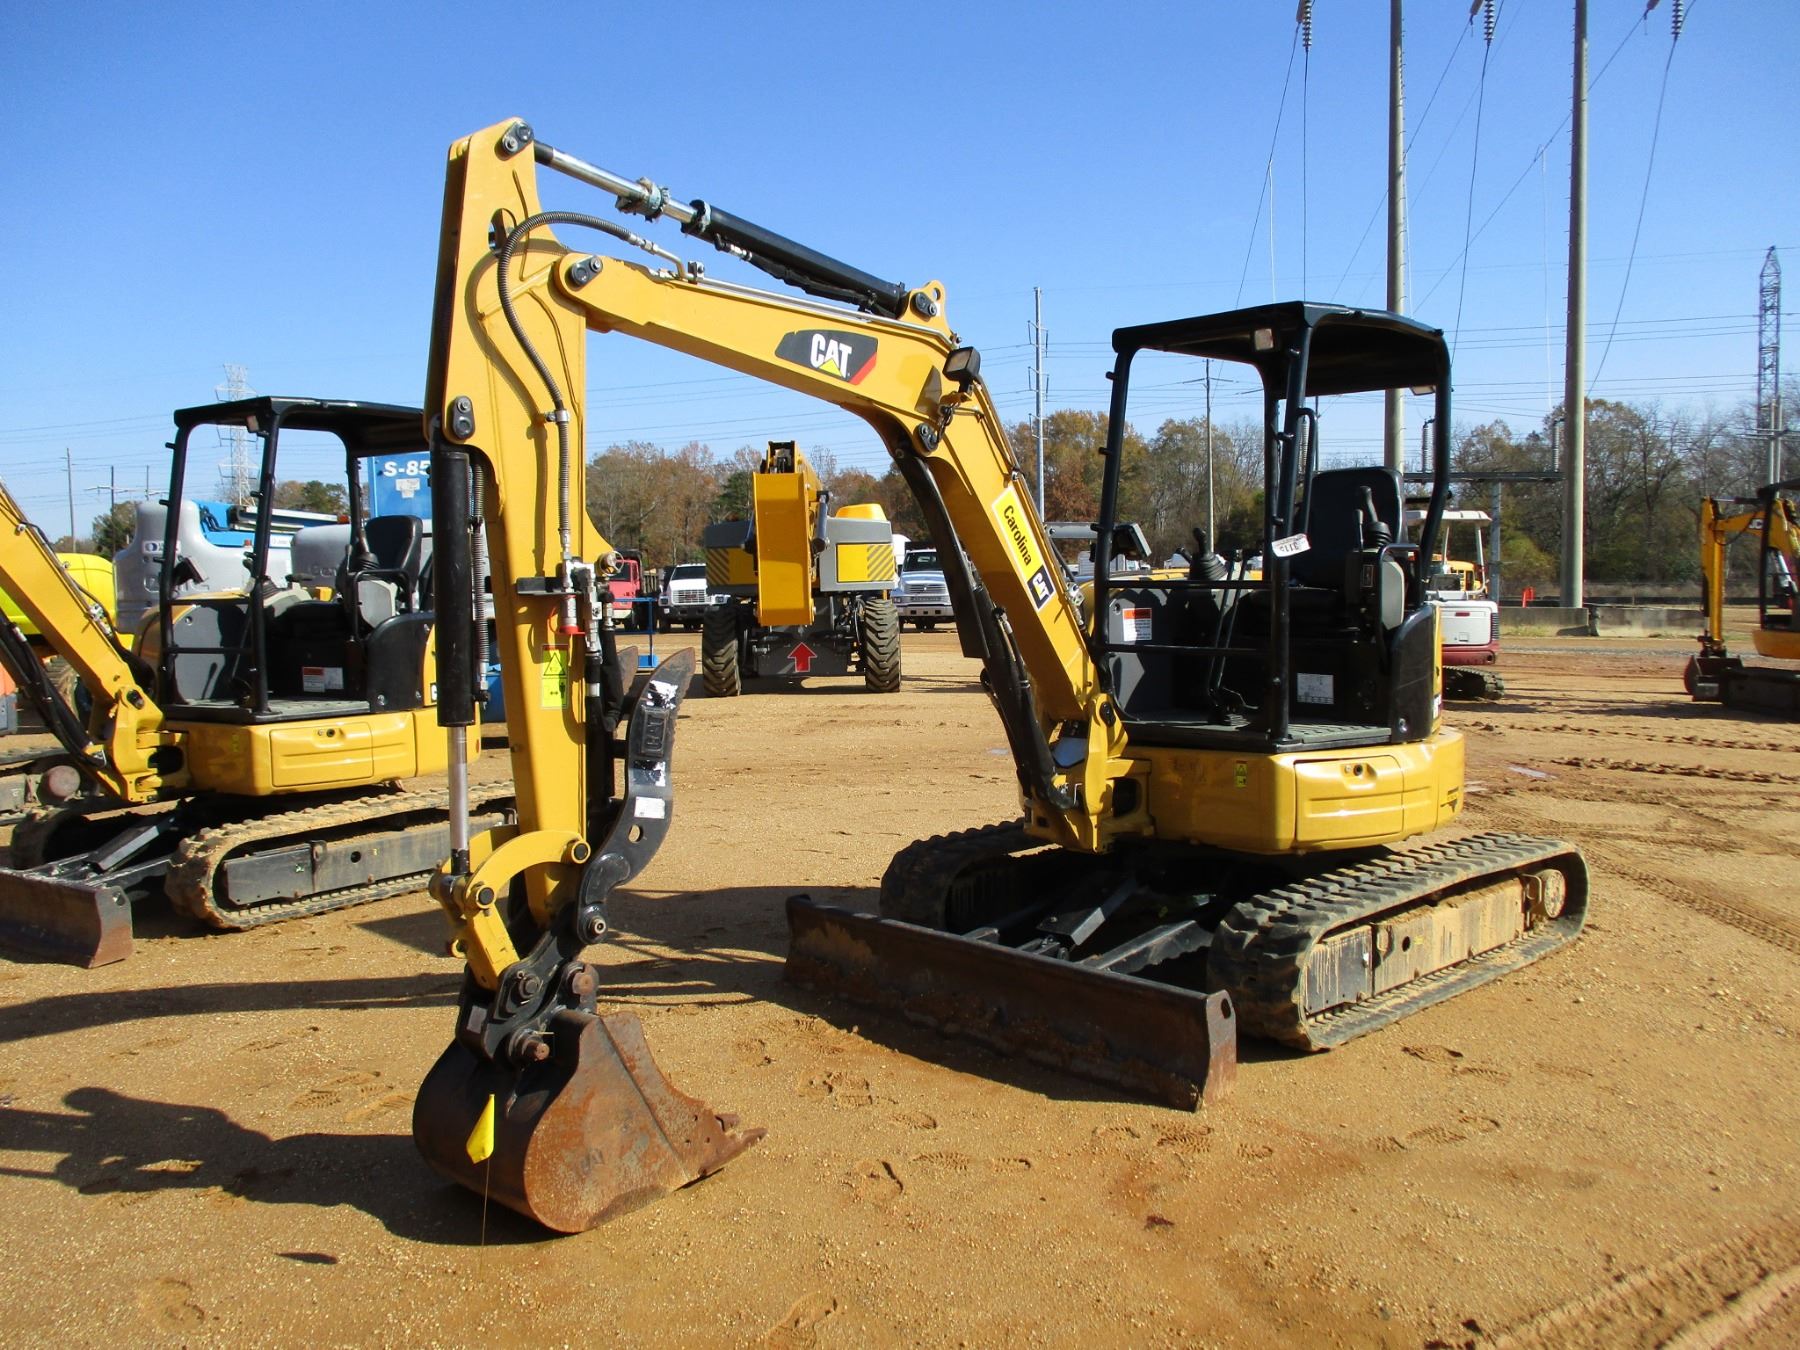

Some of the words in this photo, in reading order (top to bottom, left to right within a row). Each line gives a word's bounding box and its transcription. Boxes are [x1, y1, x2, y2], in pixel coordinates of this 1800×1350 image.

[810, 333, 852, 378] CAT
[1003, 505, 1032, 566] Carolina
[1748, 518, 1765, 530] JC
[1032, 572, 1051, 601] CAT
